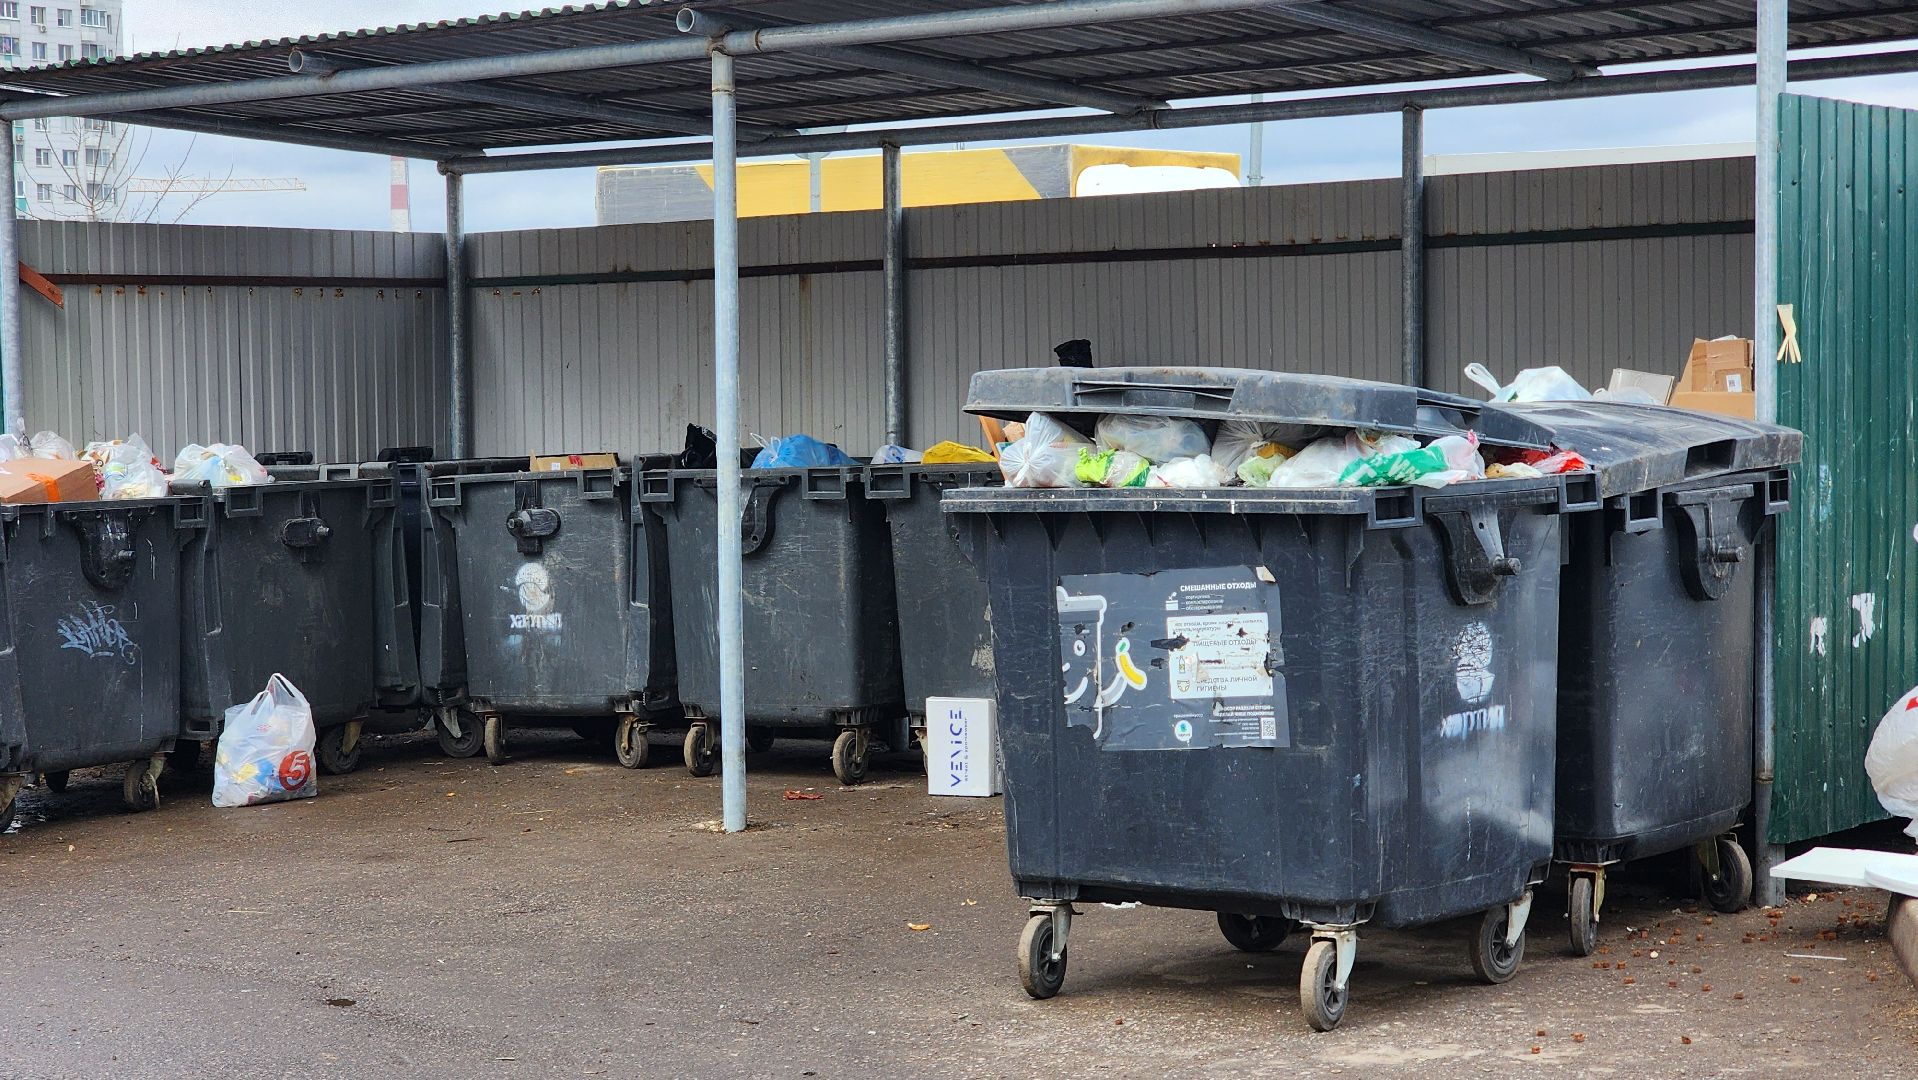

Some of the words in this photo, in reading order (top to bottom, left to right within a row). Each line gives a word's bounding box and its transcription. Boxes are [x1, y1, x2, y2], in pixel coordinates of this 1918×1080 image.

[1180, 583, 1226, 592] СМЕШАННЫЕ
[1226, 582, 1256, 590] ОТХОДЫ
[286, 752, 306, 786] 5
